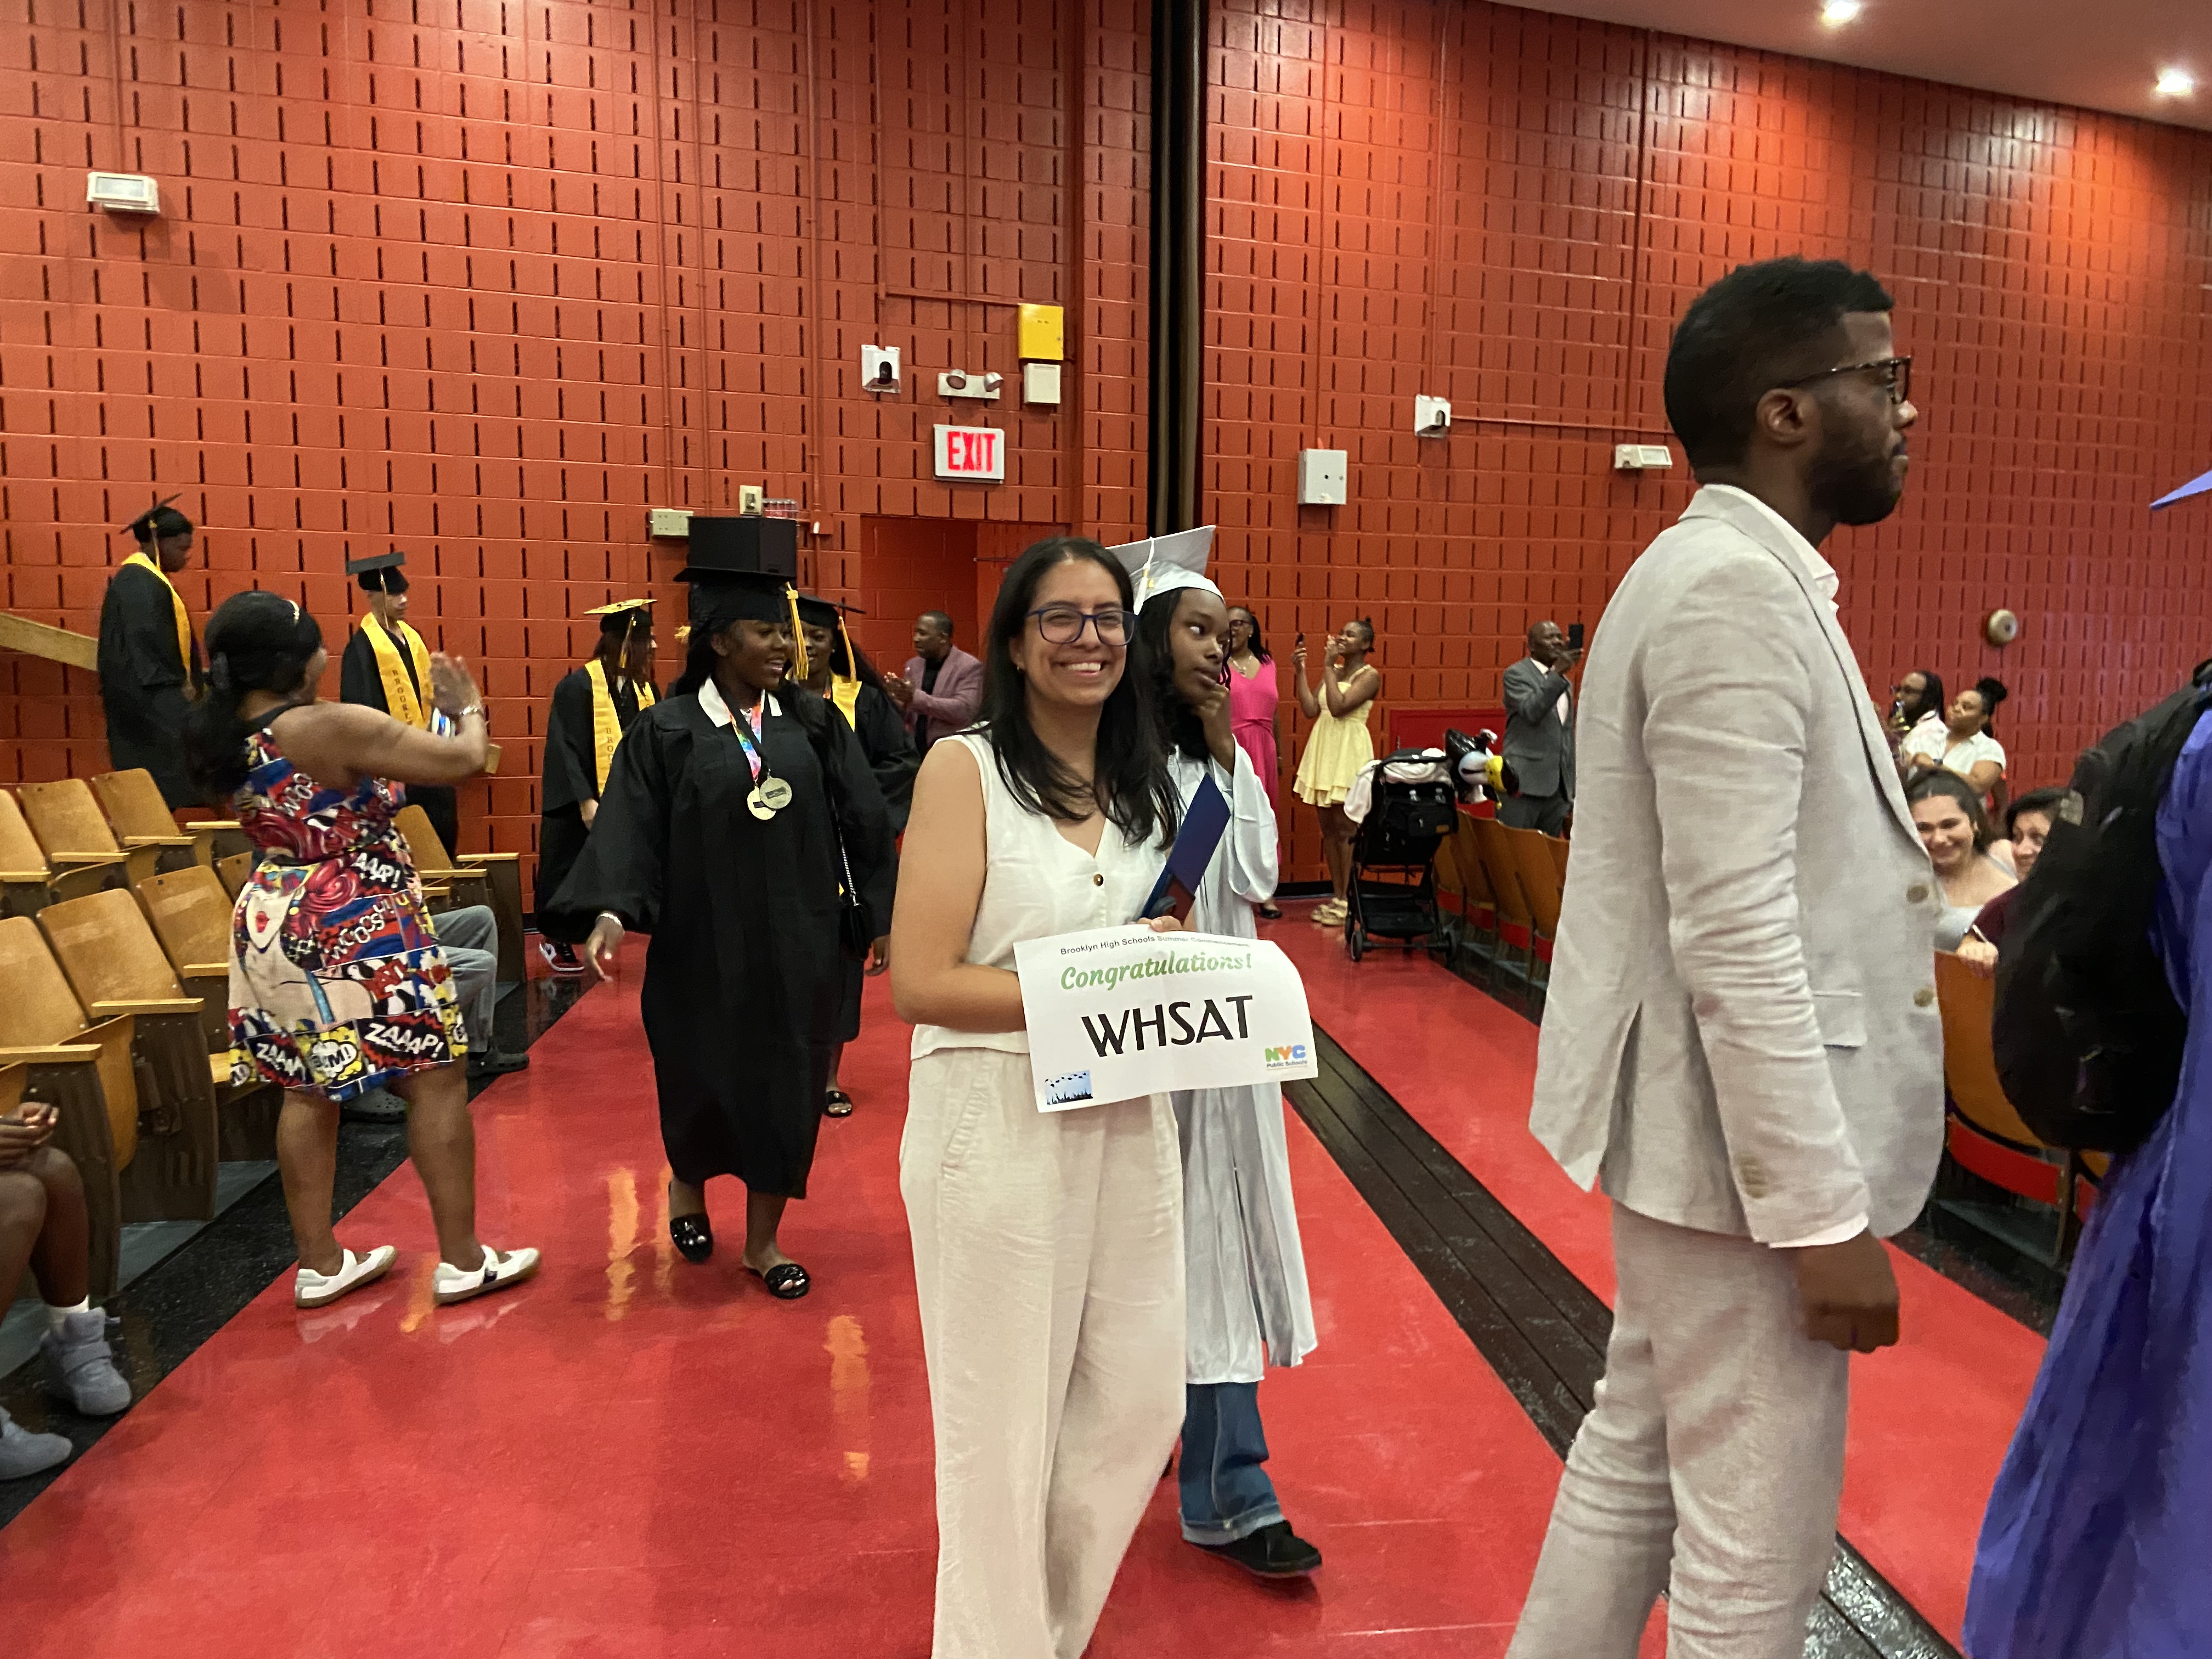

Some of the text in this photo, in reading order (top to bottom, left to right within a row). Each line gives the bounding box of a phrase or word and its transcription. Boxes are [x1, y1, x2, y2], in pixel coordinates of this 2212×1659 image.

[947, 431, 996, 472] EXIT
[1060, 944, 1098, 955] Brooklyn
[1101, 940, 1120, 949] High
[1122, 935, 1155, 945] Schools
[1061, 950, 1252, 991] Congratulations!
[1081, 995, 1253, 1057] WHSAT
[1265, 1045, 1306, 1062] NYC
